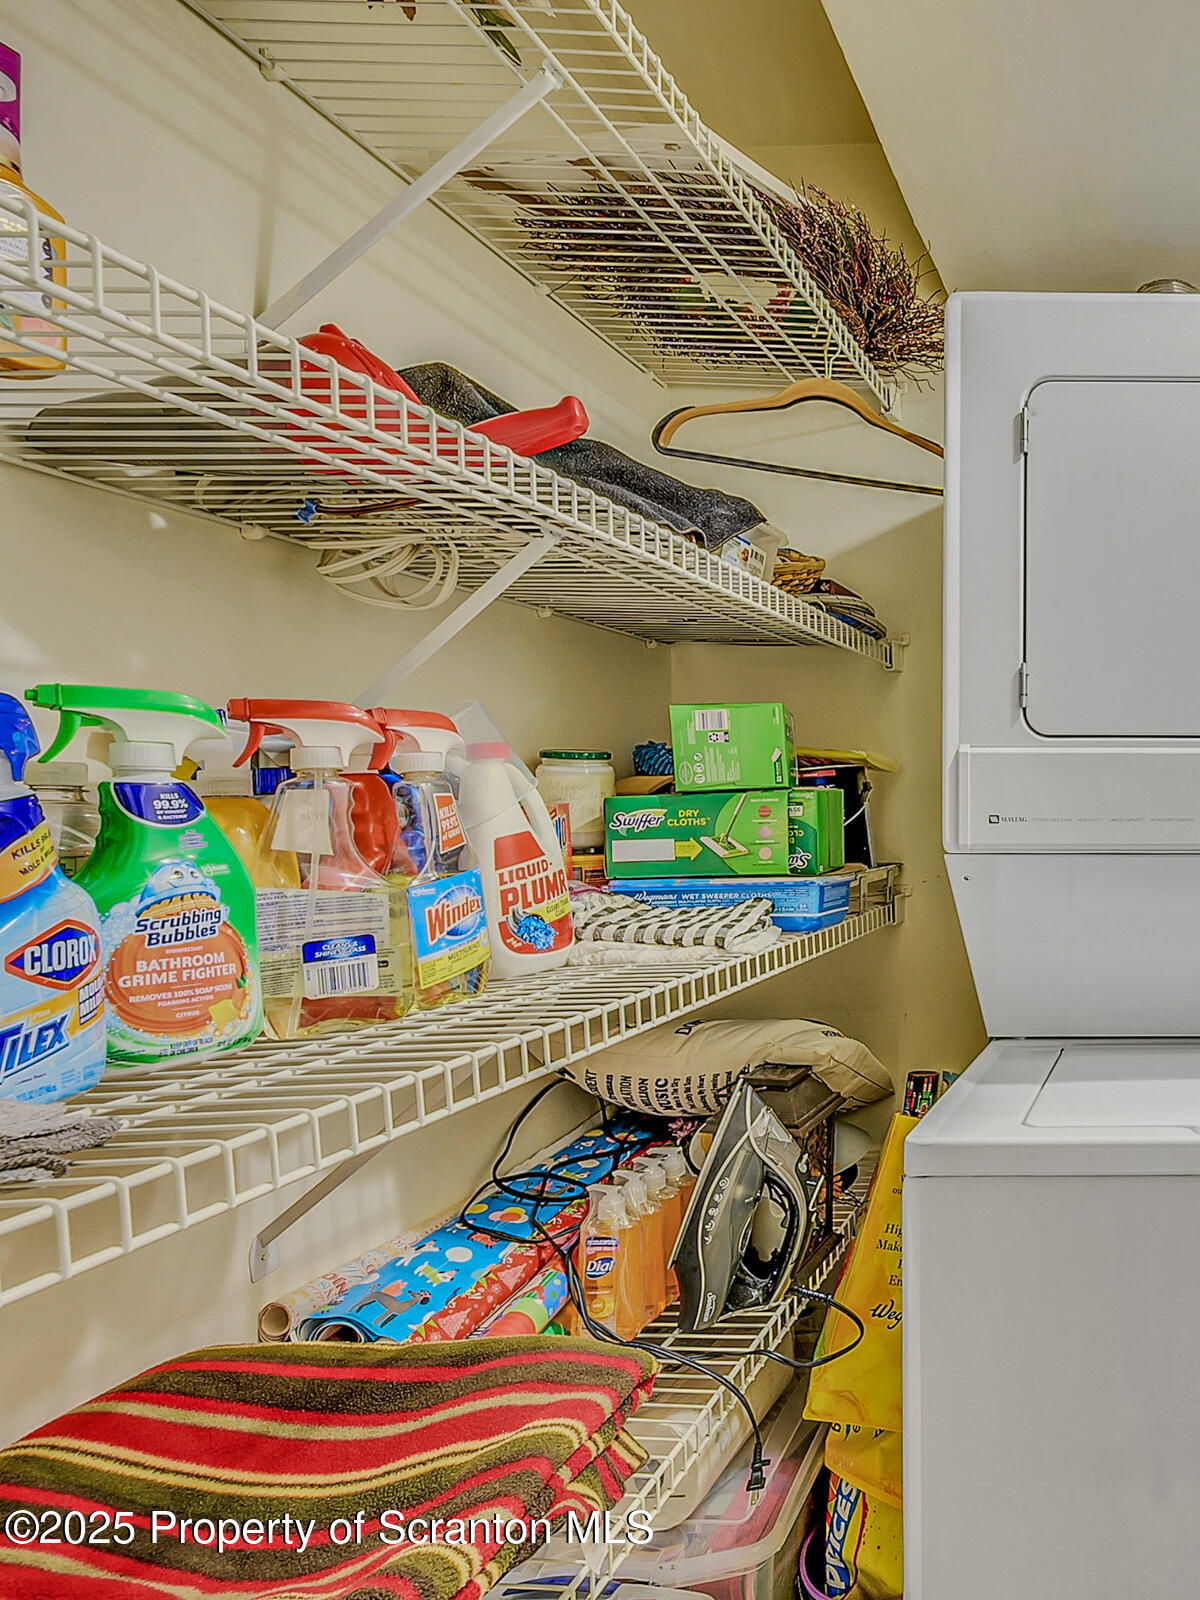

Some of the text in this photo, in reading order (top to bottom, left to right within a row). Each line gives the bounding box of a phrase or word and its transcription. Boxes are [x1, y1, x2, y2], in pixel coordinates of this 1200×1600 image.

[152, 799, 189, 809] 99.9%
[678, 809, 700, 818] DRY
[610, 813, 665, 832] Swiffer
[11, 835, 40, 860] KILLS
[500, 868, 567, 916] PLUMR
[633, 890, 677, 904] Wegmans
[701, 892, 739, 900] SWEEPER
[135, 908, 221, 933] Scrubbing
[427, 896, 481, 942] Windex
[147, 924, 217, 946] Bubbles
[24, 934, 96, 976] CLOROX
[136, 952, 225, 973] BATHROOM
[118, 963, 237, 988] GRIME FIGHTER
[129, 991, 172, 1003] REMOVES
[174, 988, 194, 998] 100%
[195, 986, 213, 995] SOAP
[655, 1078, 676, 1110] MUSIC
[587, 1259, 614, 1271] Dial
